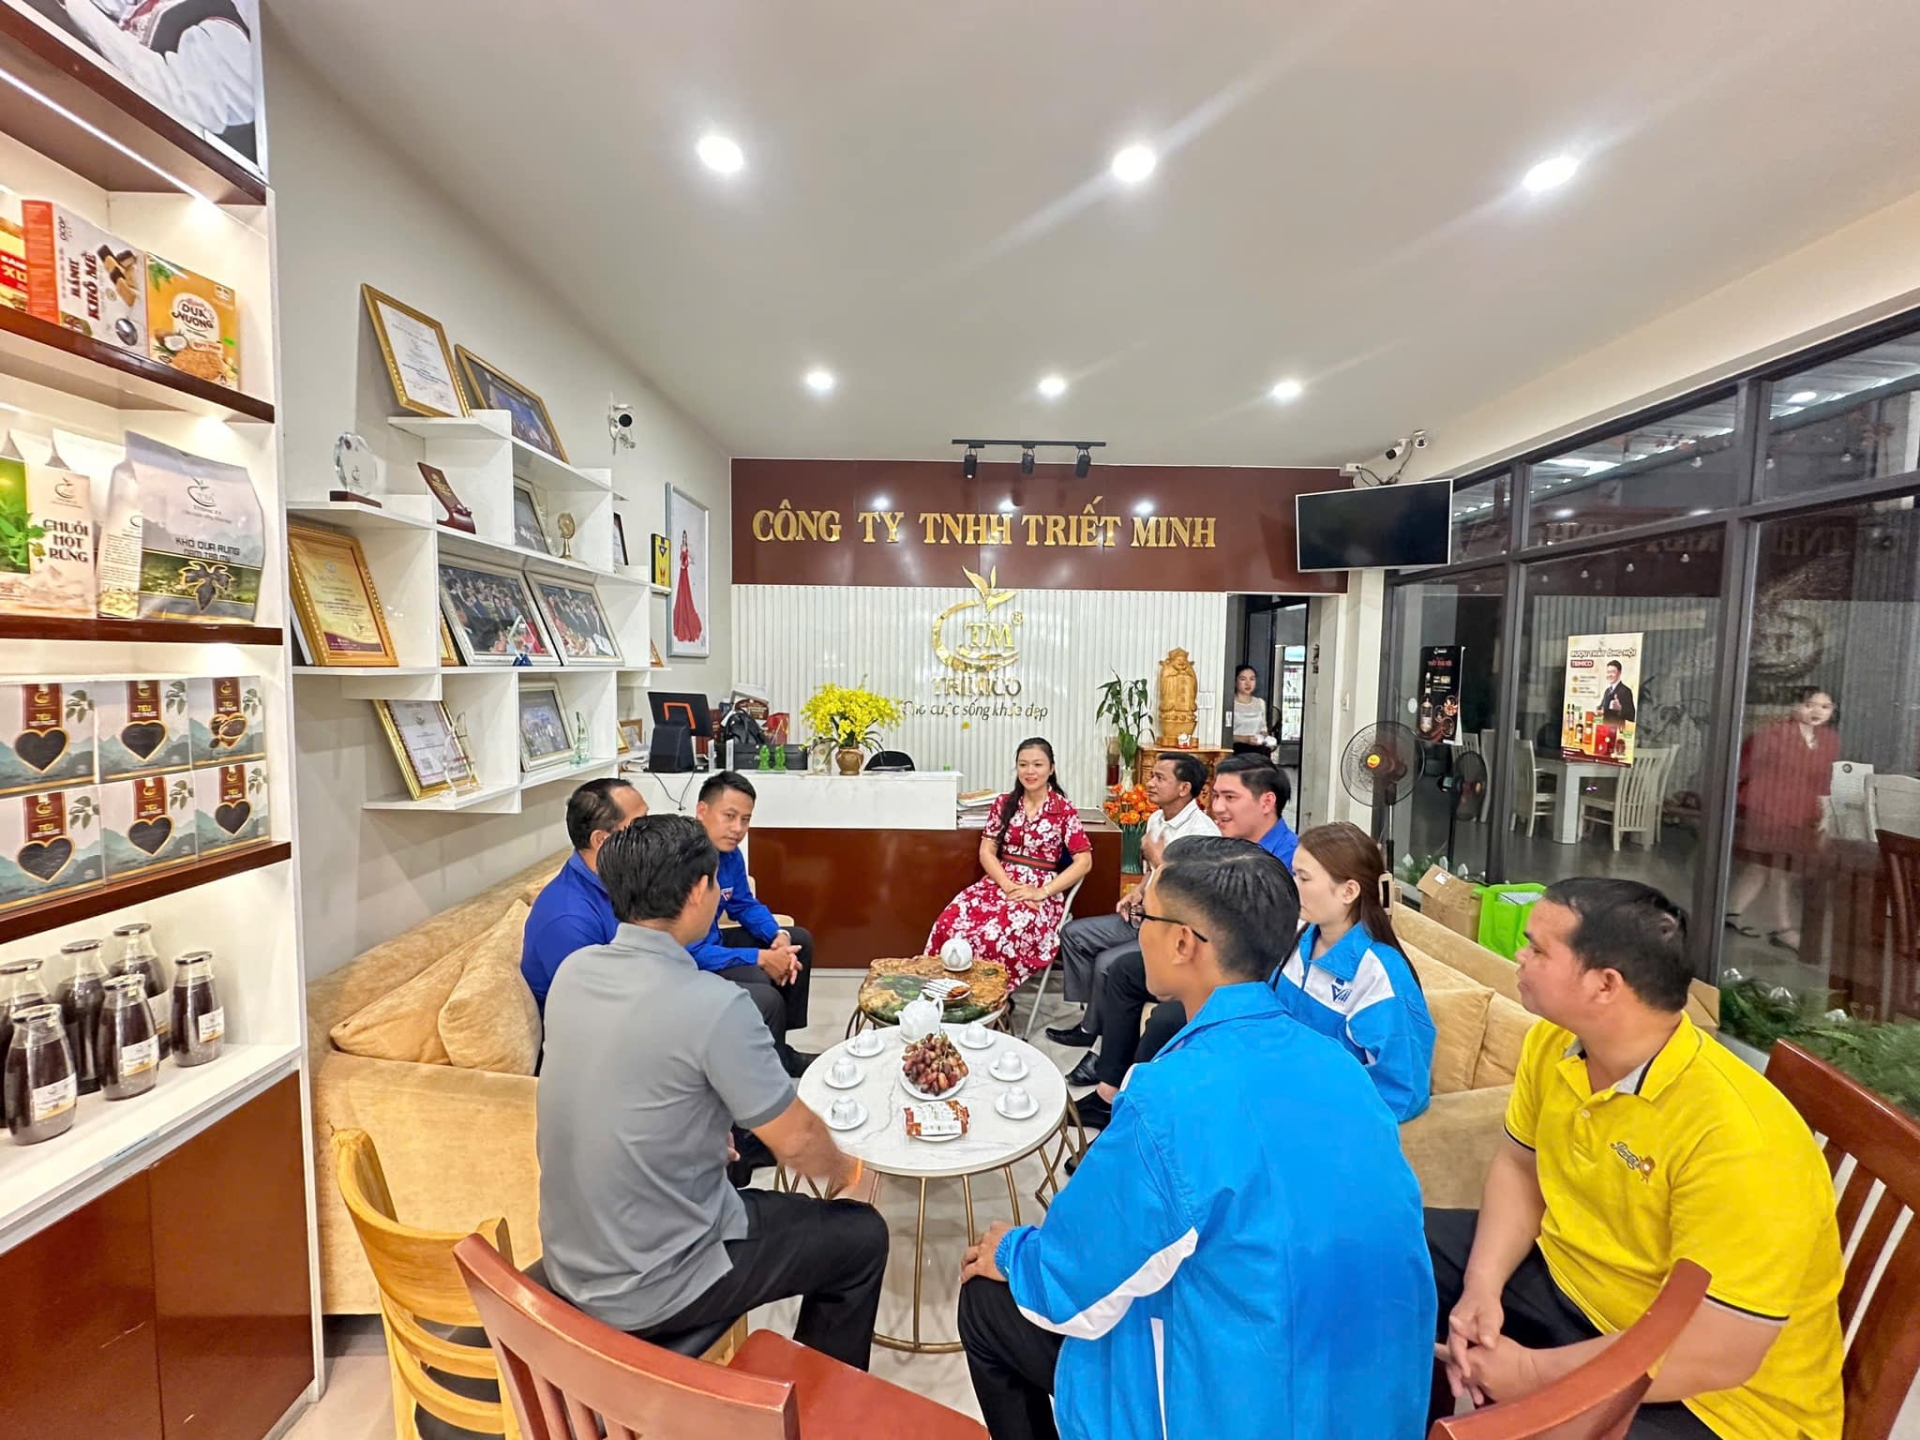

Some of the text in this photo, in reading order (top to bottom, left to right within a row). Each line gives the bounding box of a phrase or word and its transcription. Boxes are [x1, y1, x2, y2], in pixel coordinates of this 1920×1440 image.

[752, 496, 1216, 548] CÔNG TY TNHH TRIẾT MINH
[964, 621, 1015, 649] TM
[930, 676, 1022, 697] TRIMICO
[963, 698, 990, 720] sống
[1025, 702, 1048, 722] đẹp
